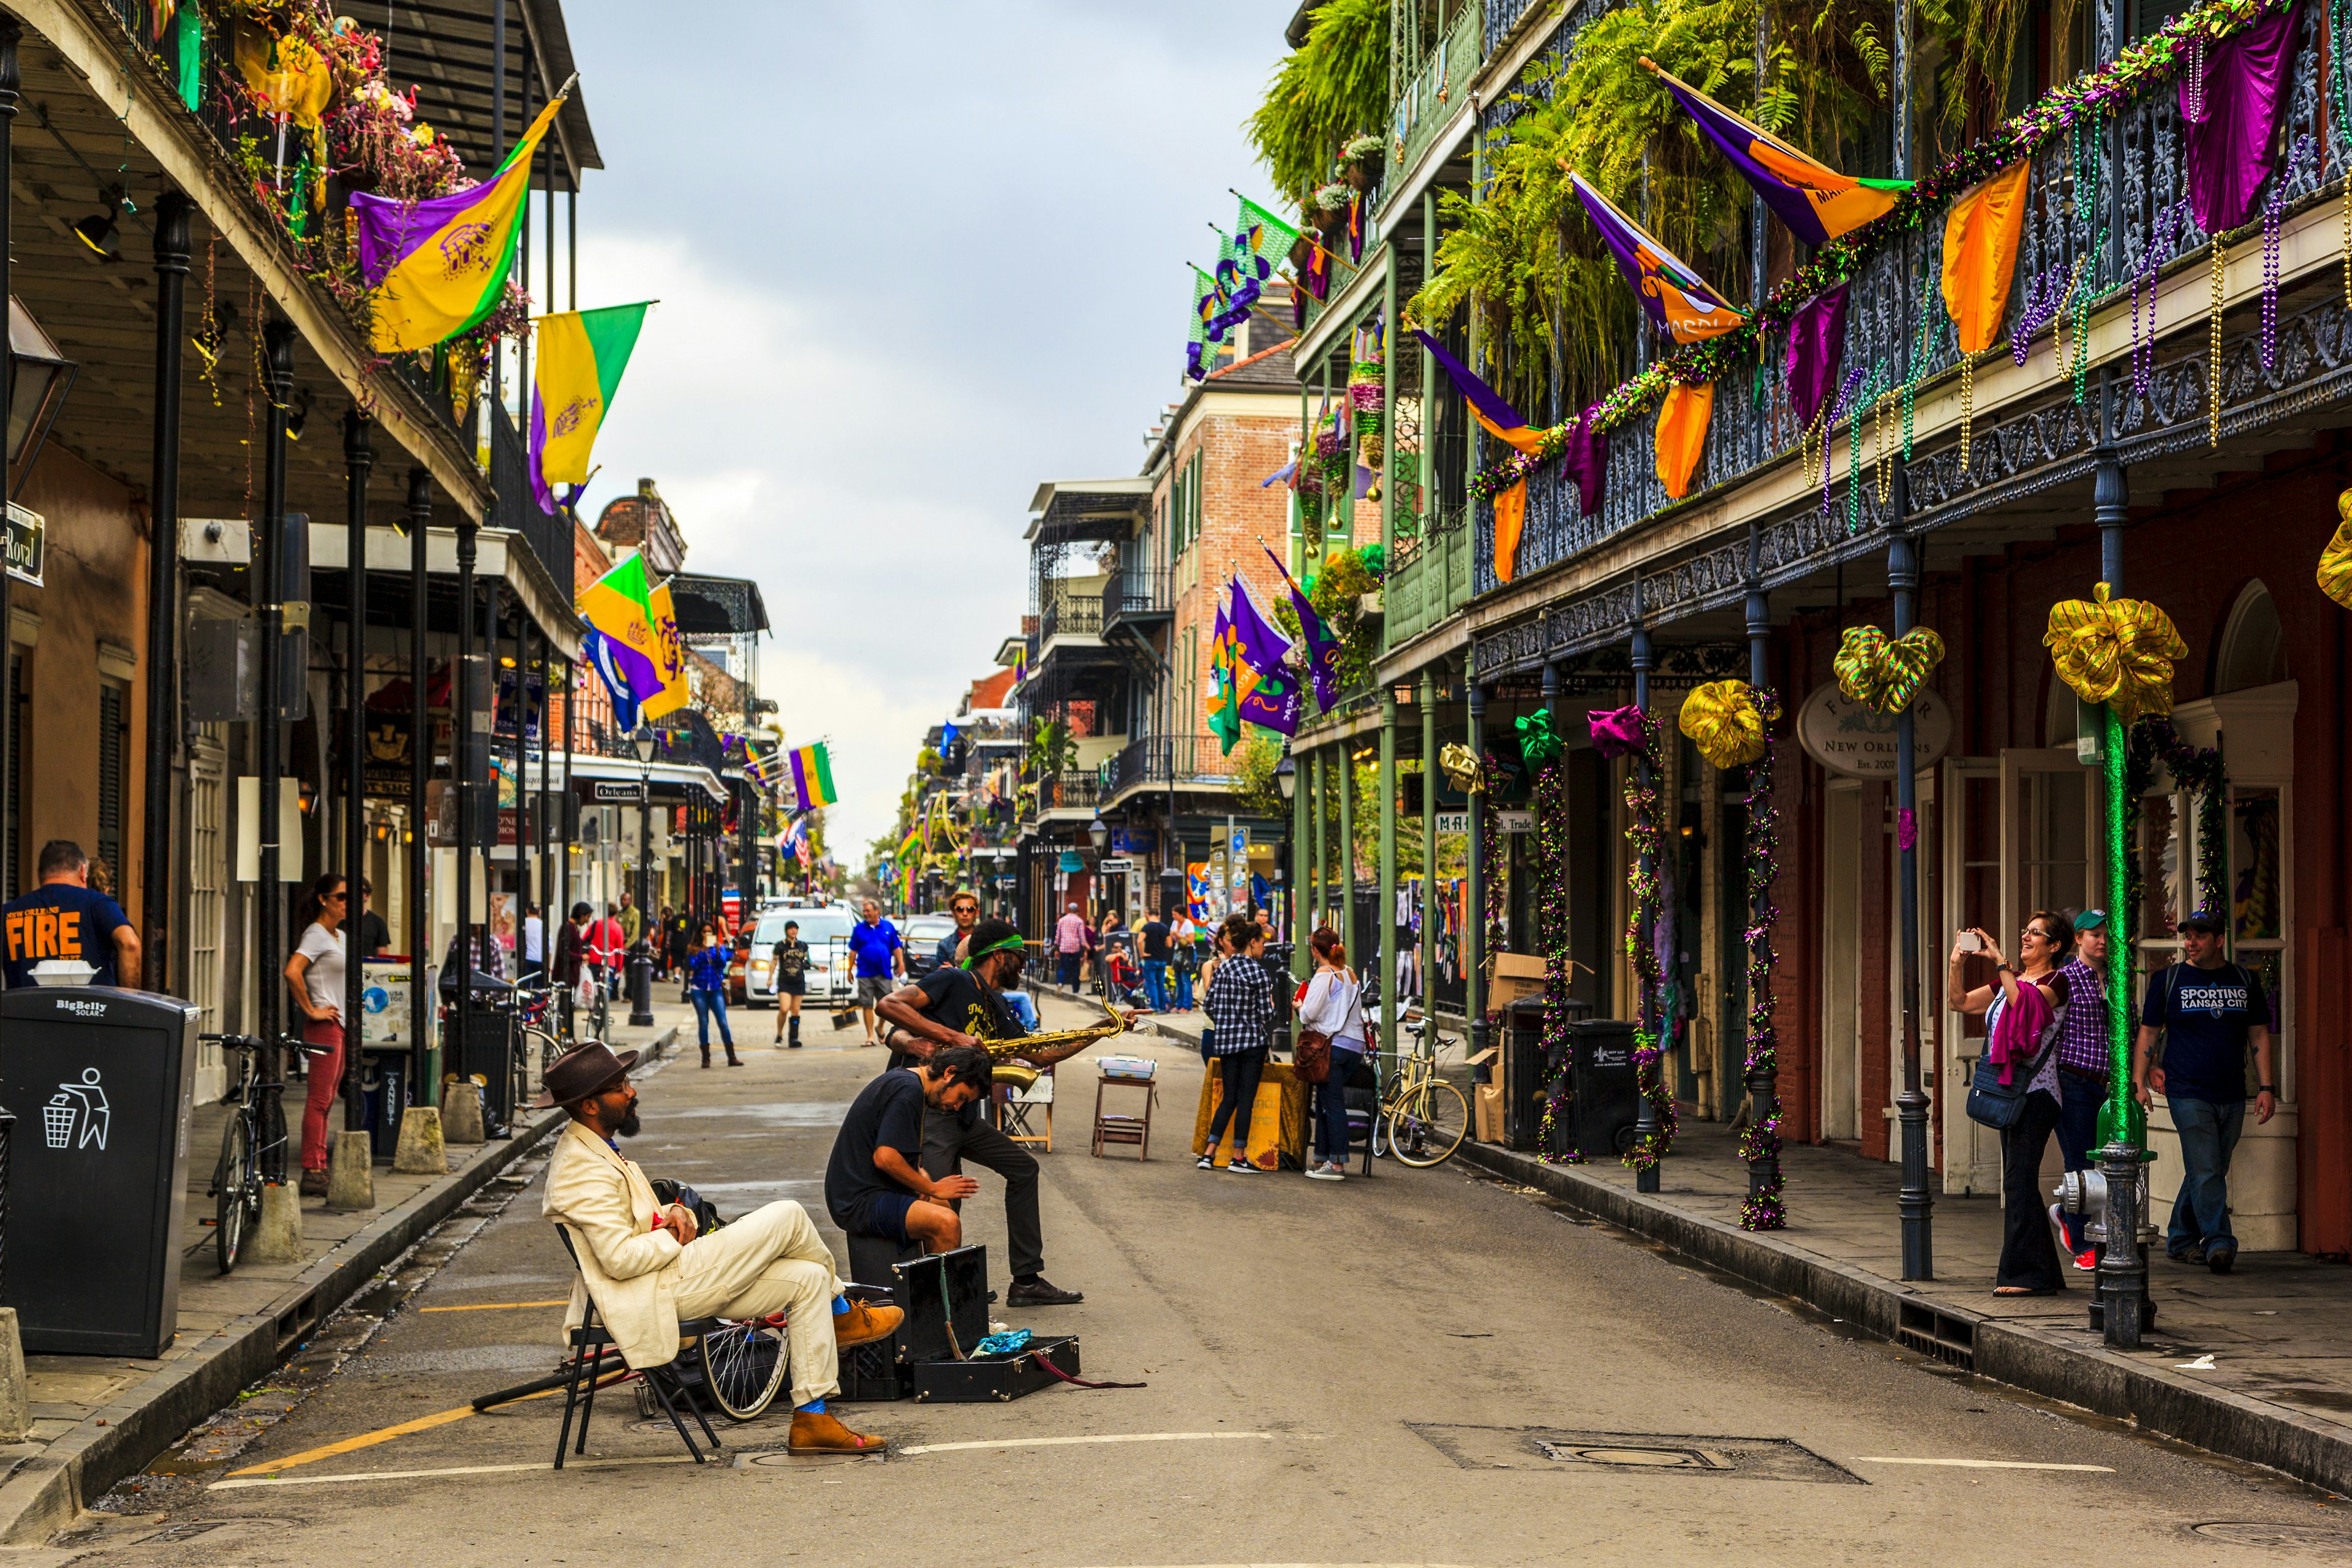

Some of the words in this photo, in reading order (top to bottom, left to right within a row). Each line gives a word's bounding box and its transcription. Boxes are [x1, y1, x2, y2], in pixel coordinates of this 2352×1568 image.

[6, 527, 34, 568] Royal
[1864, 741, 1930, 753] ORLNS
[1857, 760, 1871, 769] Est.
[1875, 760, 1895, 769] 2007
[1509, 819, 1531, 829] Trade
[24, 907, 59, 916] ORLEANS
[6, 911, 81, 961] FIRE
[2180, 989, 2247, 1000] SPORTING
[56, 1000, 107, 1012] BigBelly
[2181, 999, 2224, 1009] KANSAS
[2227, 999, 2247, 1008] CITY
